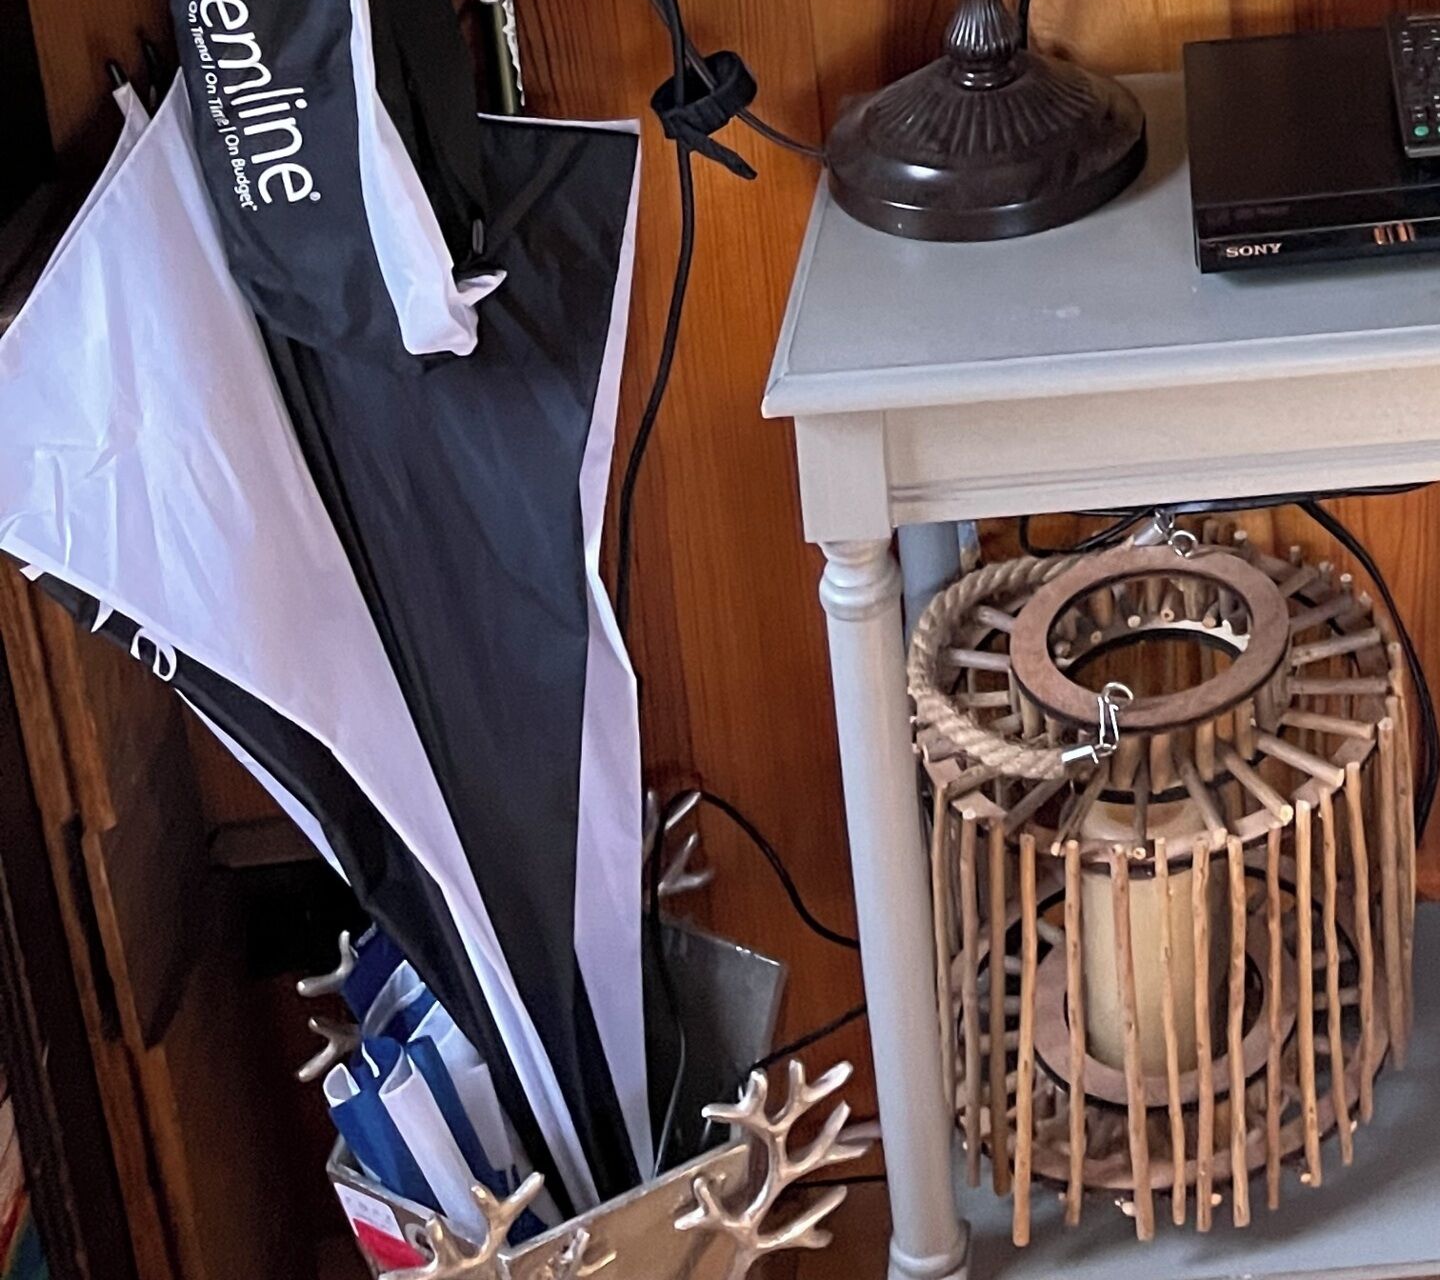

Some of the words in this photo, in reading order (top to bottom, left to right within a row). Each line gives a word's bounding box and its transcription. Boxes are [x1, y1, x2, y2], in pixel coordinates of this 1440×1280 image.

[187, 0, 199, 23] On
[190, 25, 213, 63] Trend
[204, 71, 218, 94] On
[207, 96, 230, 128] Time
[224, 132, 240, 156] On
[230, 157, 254, 210] Budget
[1225, 242, 1282, 258] SONY
